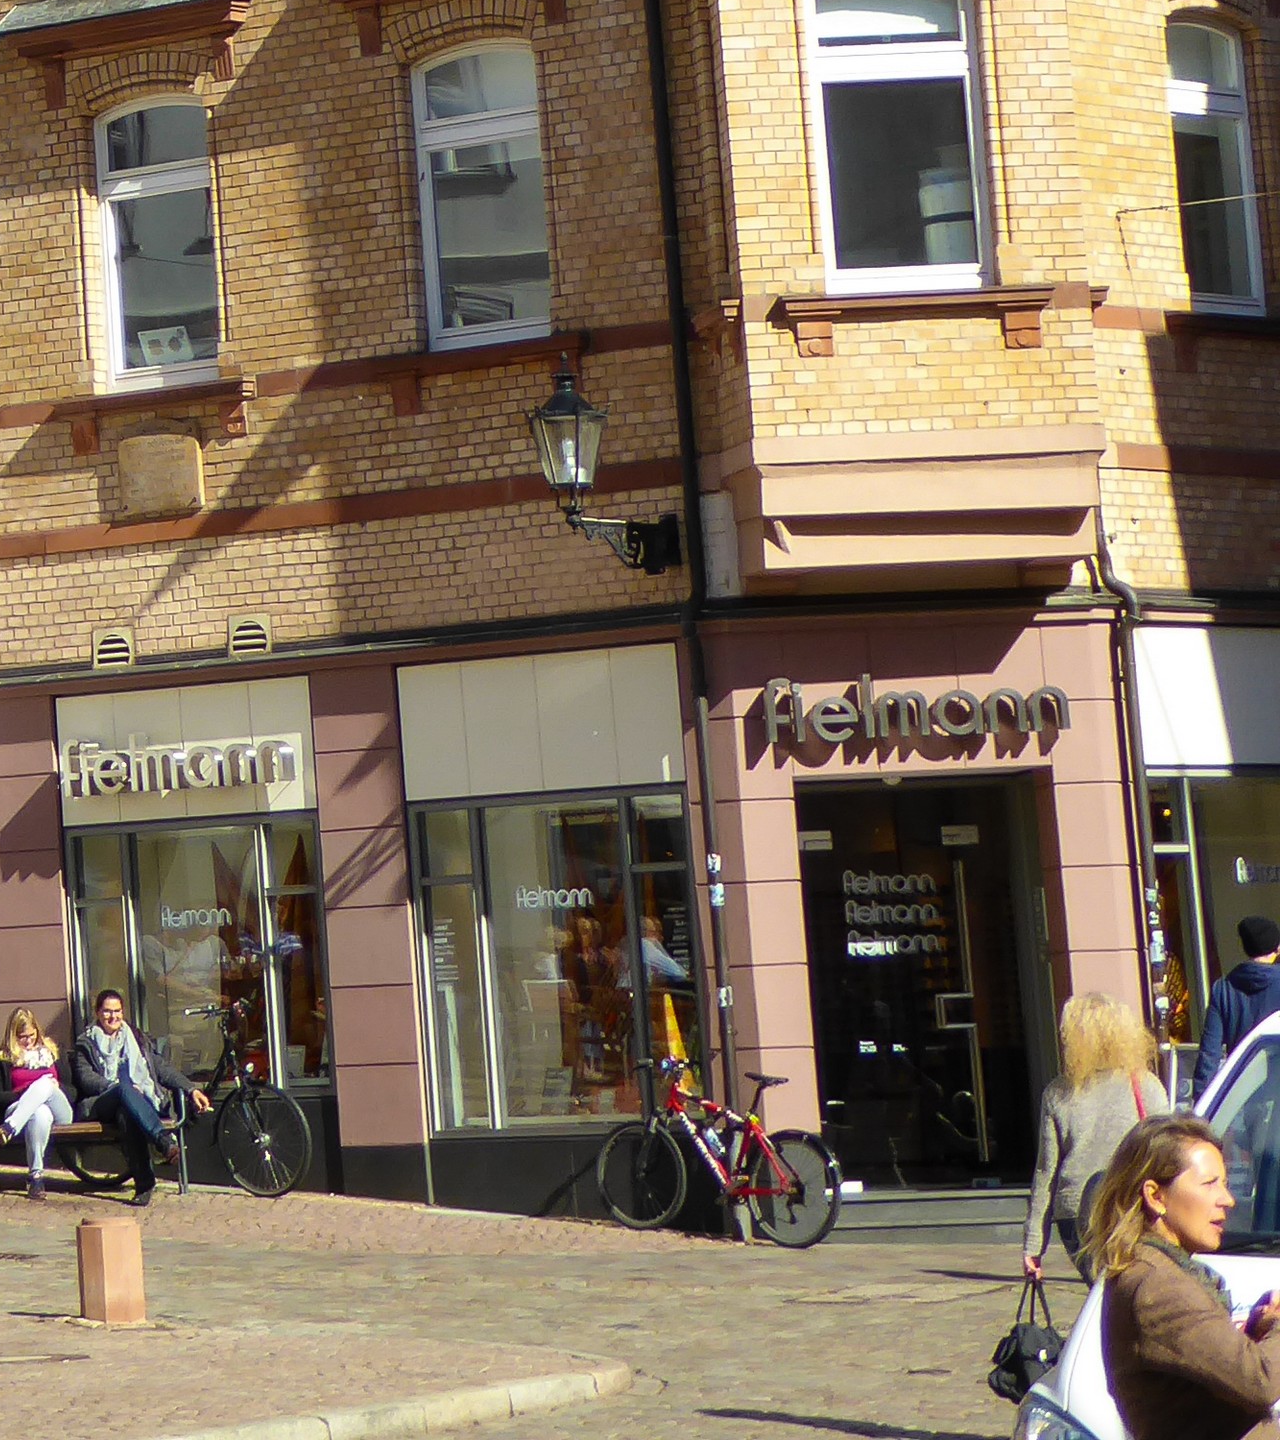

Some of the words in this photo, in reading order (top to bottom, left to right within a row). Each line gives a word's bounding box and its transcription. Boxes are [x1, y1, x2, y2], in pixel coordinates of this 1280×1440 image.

[763, 673, 1072, 743] fielmann
[61, 732, 297, 798] fielmann
[842, 870, 936, 894] fielmann
[516, 885, 596, 908] fielmann
[161, 905, 233, 928] fielmann
[845, 900, 939, 924] fielmann
[847, 930, 941, 956] fielmann
